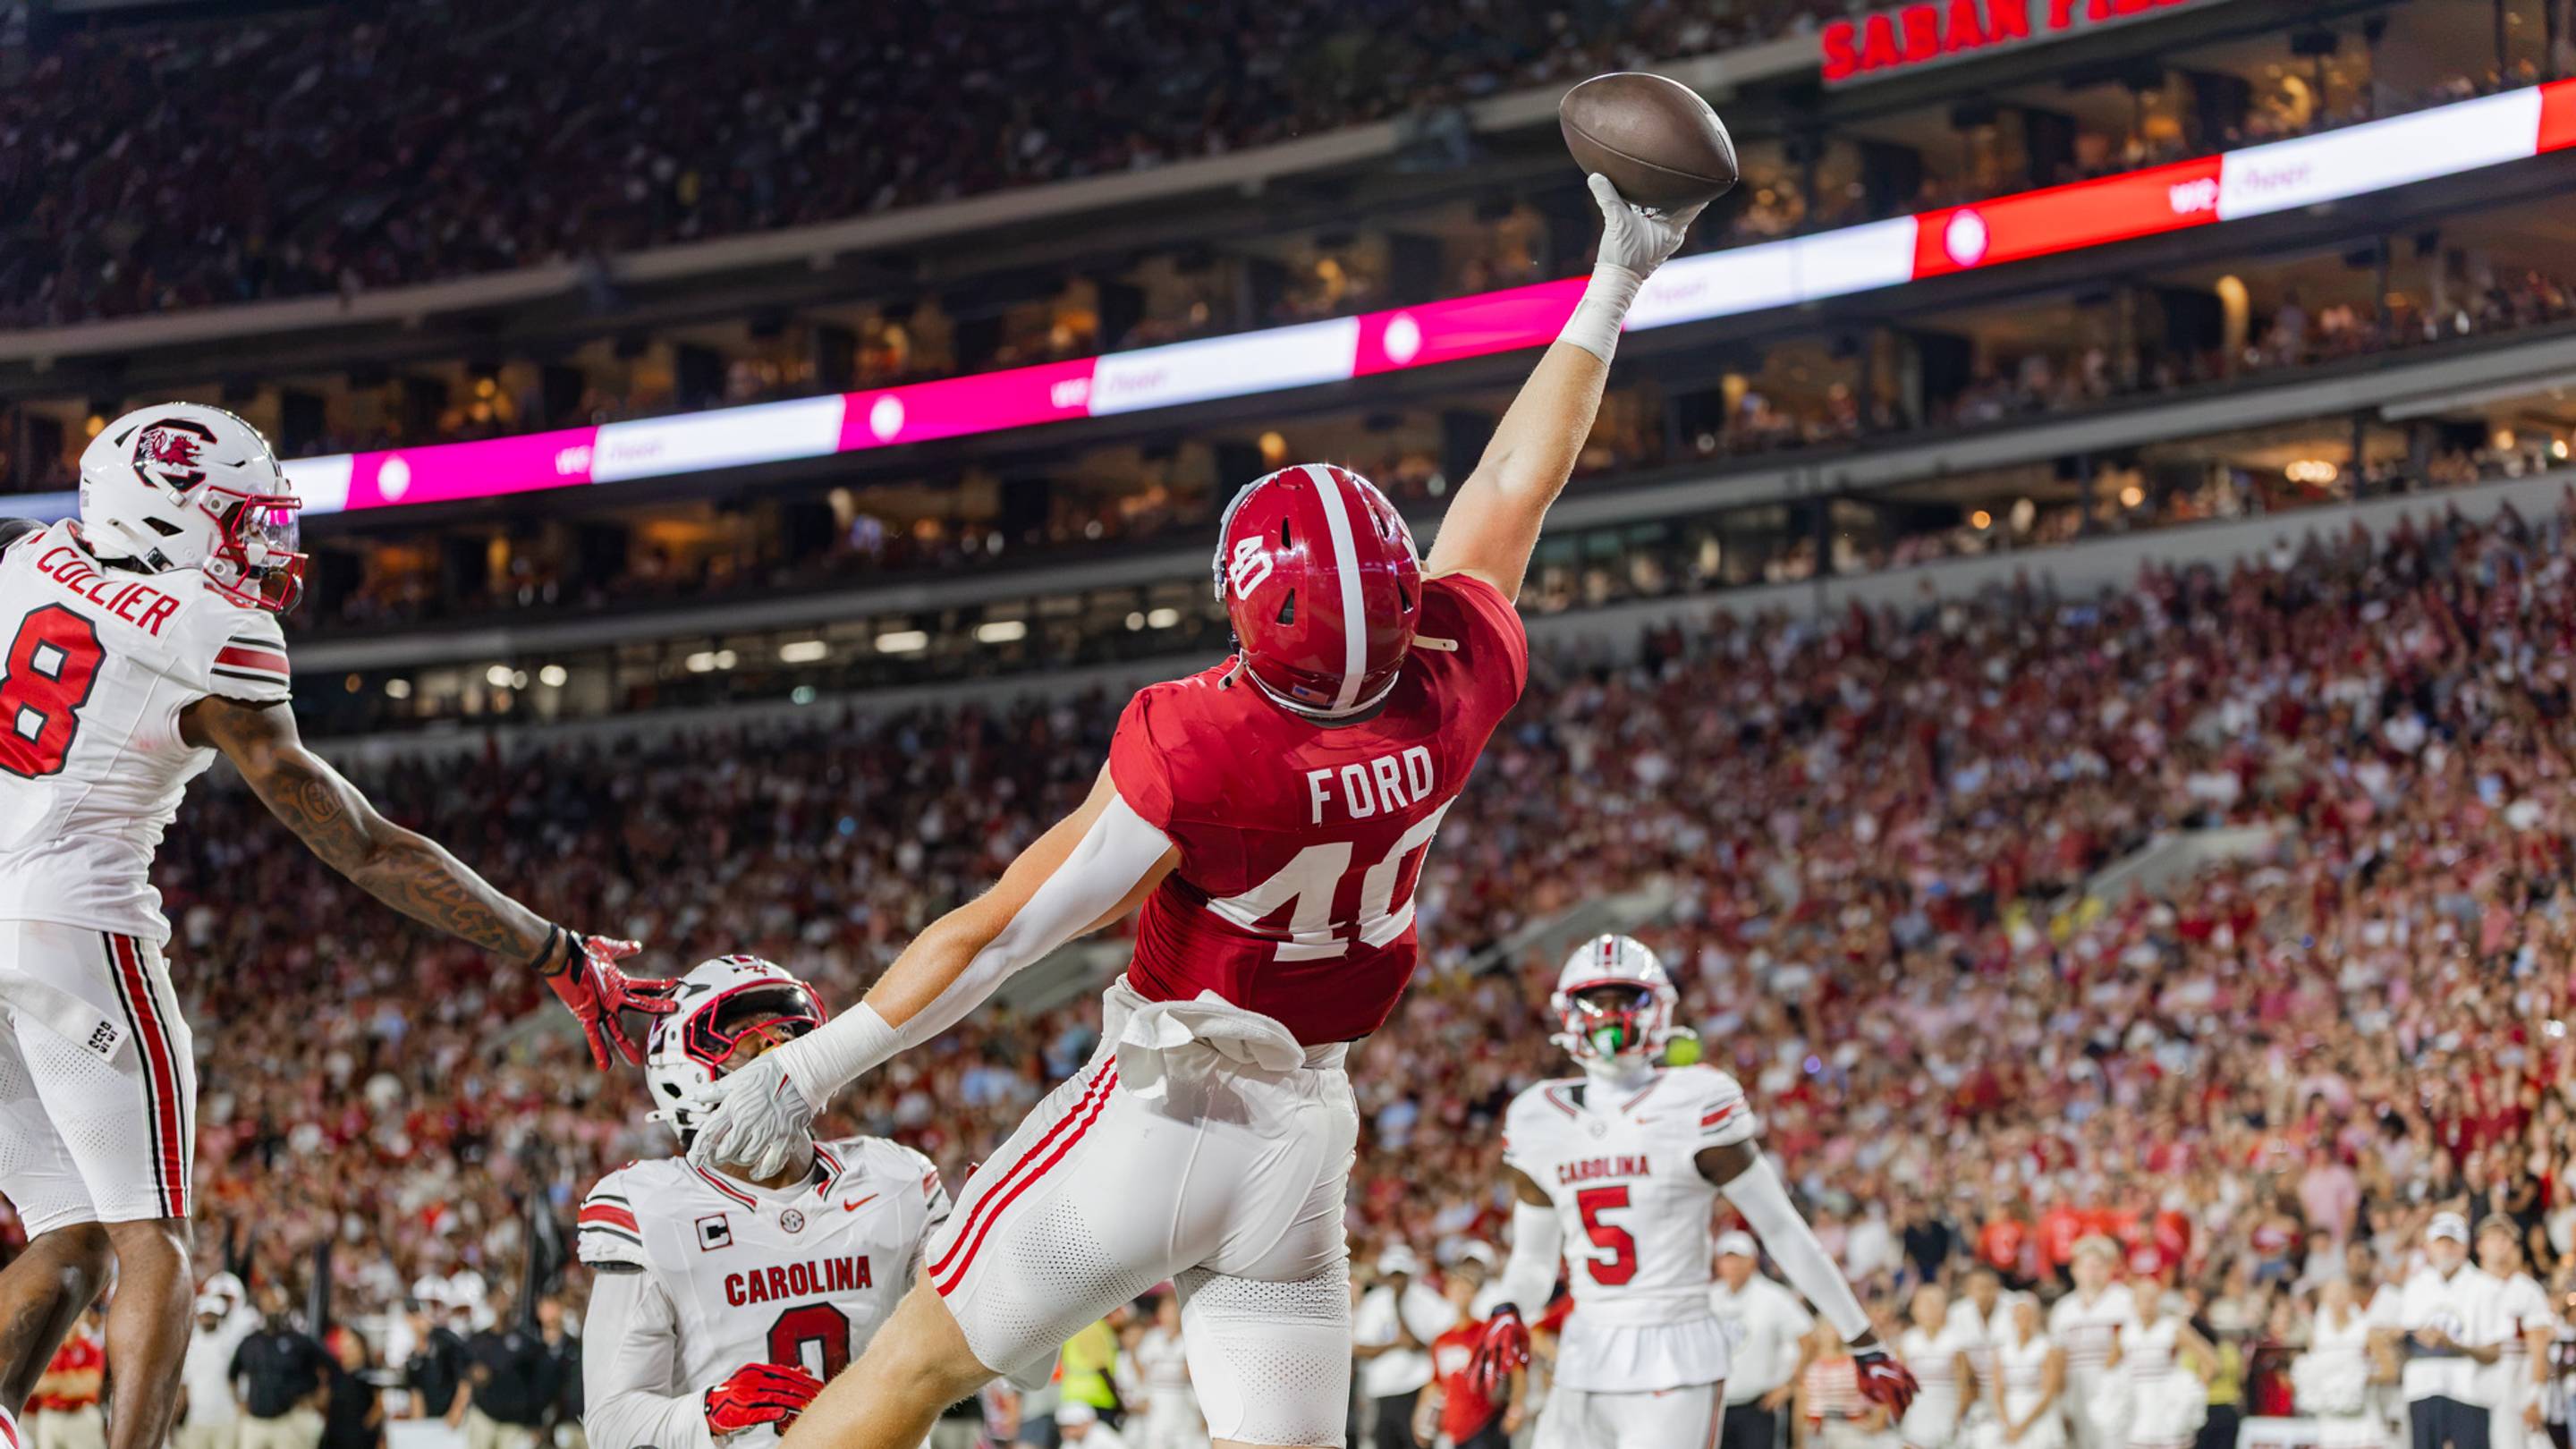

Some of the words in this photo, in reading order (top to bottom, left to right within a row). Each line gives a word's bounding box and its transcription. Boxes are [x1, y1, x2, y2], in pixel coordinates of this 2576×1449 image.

[1822, 0, 2029, 80] SABAN
[37, 547, 181, 637] COLLIER
[1229, 535, 1274, 601] 40
[0, 601, 107, 780] 8
[1307, 745, 1434, 827] FORD
[1206, 794, 1459, 962] 40
[1556, 1155, 1649, 1184] CAROLINA
[1577, 1185, 1638, 1287] 5
[724, 1255, 873, 1308] CAROLINA
